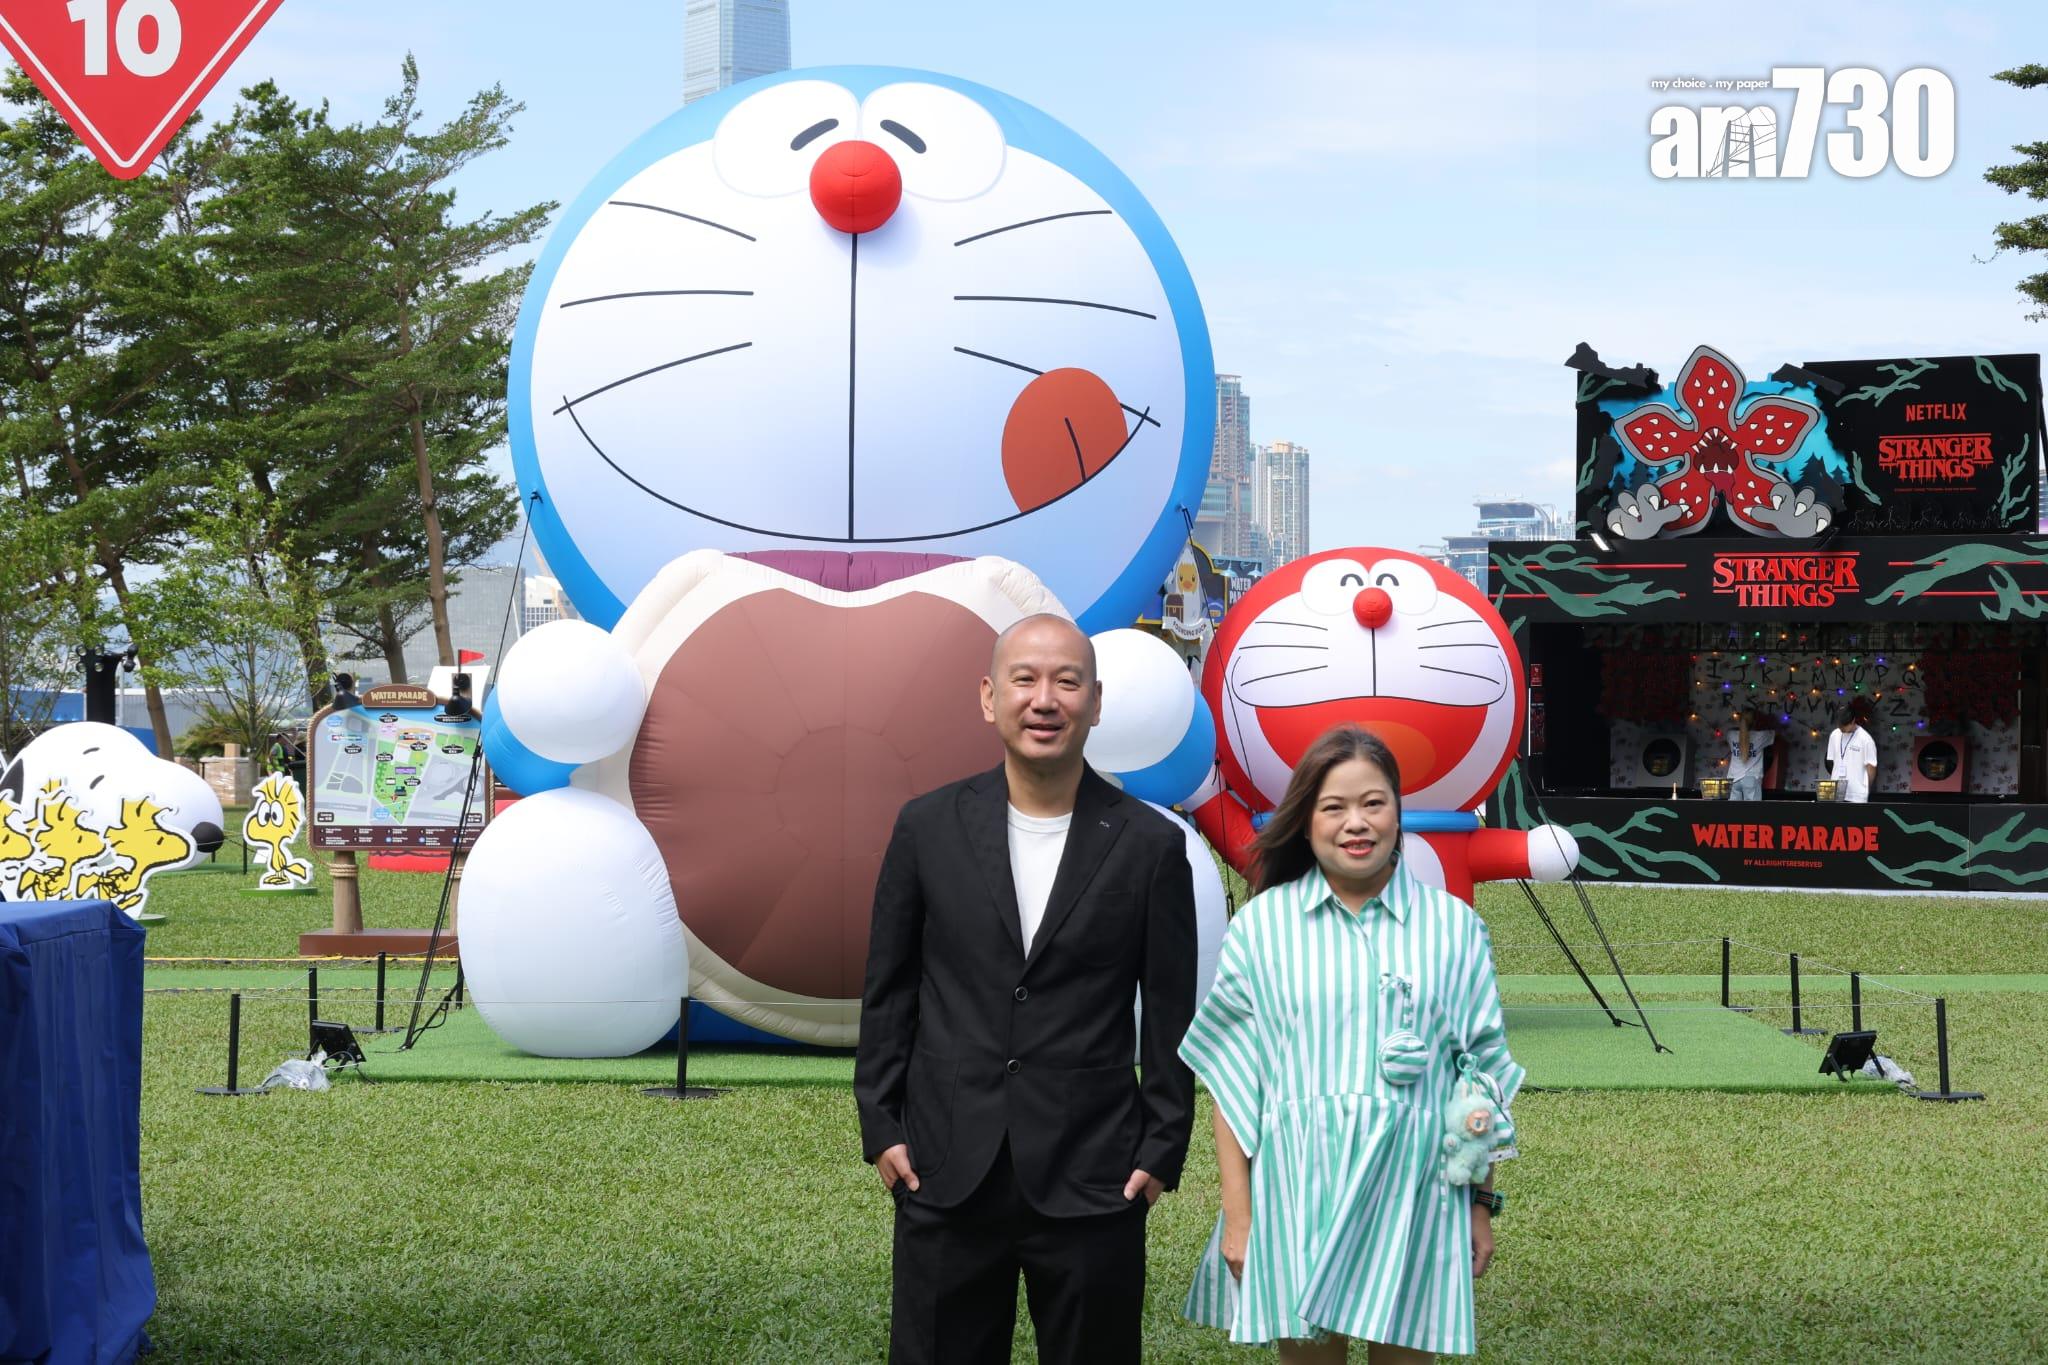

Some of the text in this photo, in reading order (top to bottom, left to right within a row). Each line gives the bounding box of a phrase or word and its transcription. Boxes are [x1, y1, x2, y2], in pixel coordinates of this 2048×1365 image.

[66, 0, 182, 77] 10
[1905, 403, 1967, 422] NETFLIX
[1879, 437, 1994, 463] STRANGER
[1896, 459, 1975, 480] THINGS
[1712, 557, 1860, 587] STRANGER
[1734, 583, 1836, 607] THINGS
[370, 691, 428, 702] WATER PARADE
[1691, 823, 1880, 851] WATER PARADE
[1753, 859, 1823, 868] ALLRIGHTSRESERVED
